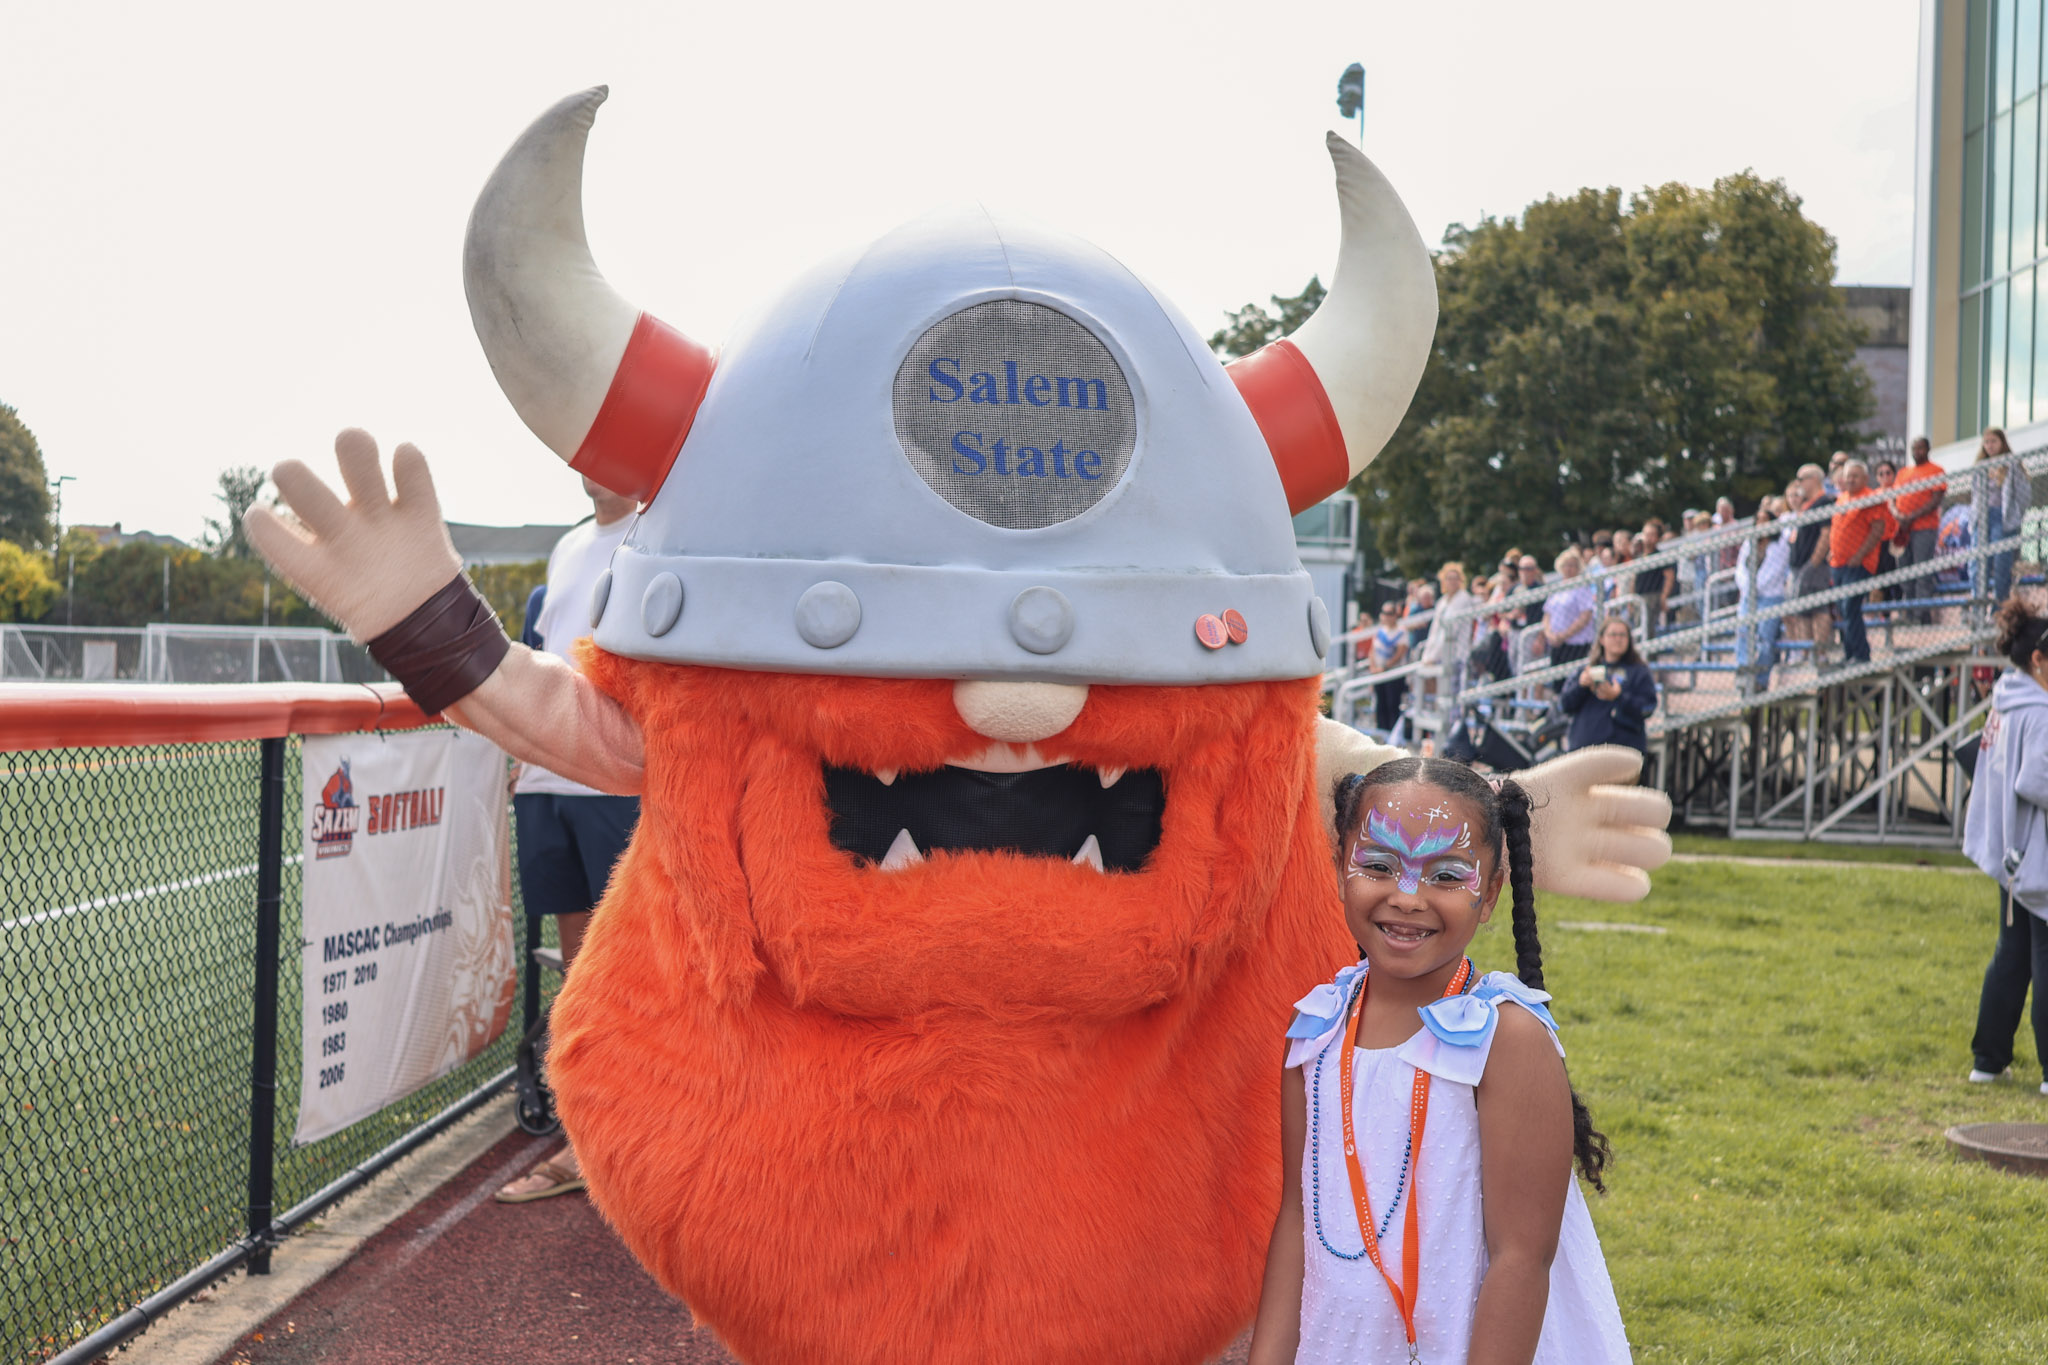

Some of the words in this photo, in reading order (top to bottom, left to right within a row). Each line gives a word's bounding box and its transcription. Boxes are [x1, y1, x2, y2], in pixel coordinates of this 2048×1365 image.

[928, 357, 1110, 411] Salem
[950, 430, 1104, 481] State
[323, 925, 380, 963] MASCAC
[383, 906, 453, 947] Champinhips
[323, 970, 347, 994] 1977
[354, 962, 378, 986] 2010
[322, 1001, 348, 1025] 1980
[322, 1032, 346, 1057] 1983
[320, 1062, 345, 1089] 2006
[1343, 1101, 1353, 1142] Salem
